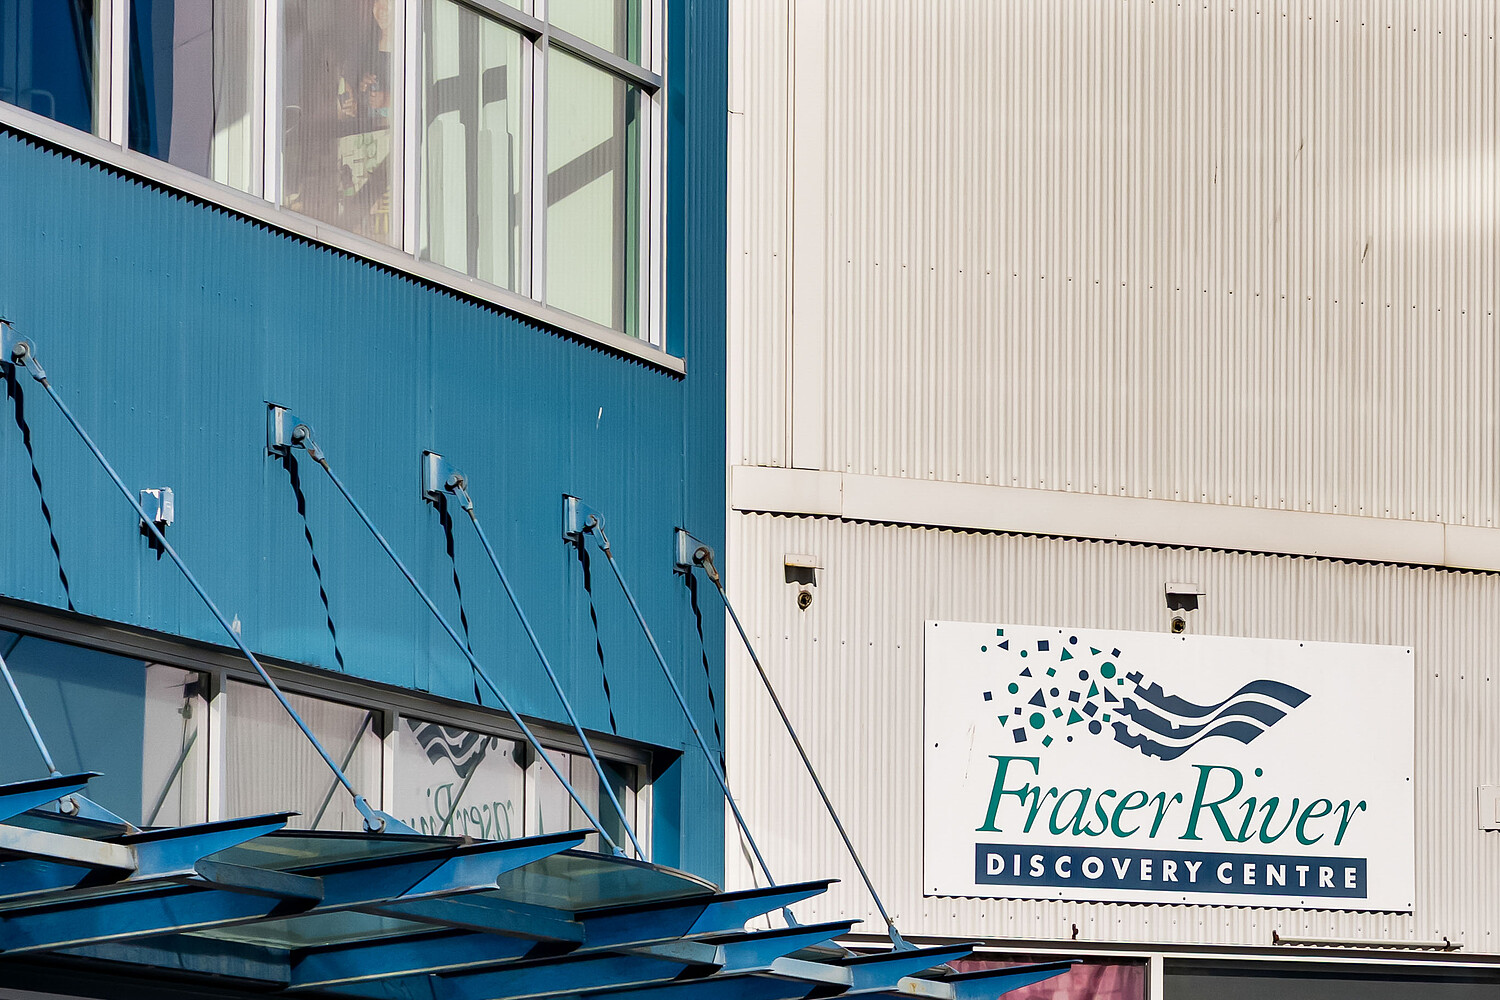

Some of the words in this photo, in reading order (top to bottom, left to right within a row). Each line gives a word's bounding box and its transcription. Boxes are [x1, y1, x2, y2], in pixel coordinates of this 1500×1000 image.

[975, 755, 1182, 839] Fraser
[1178, 764, 1367, 846] River
[986, 853, 1202, 883] DISCOVERY
[1217, 862, 1357, 889] CENTRE
